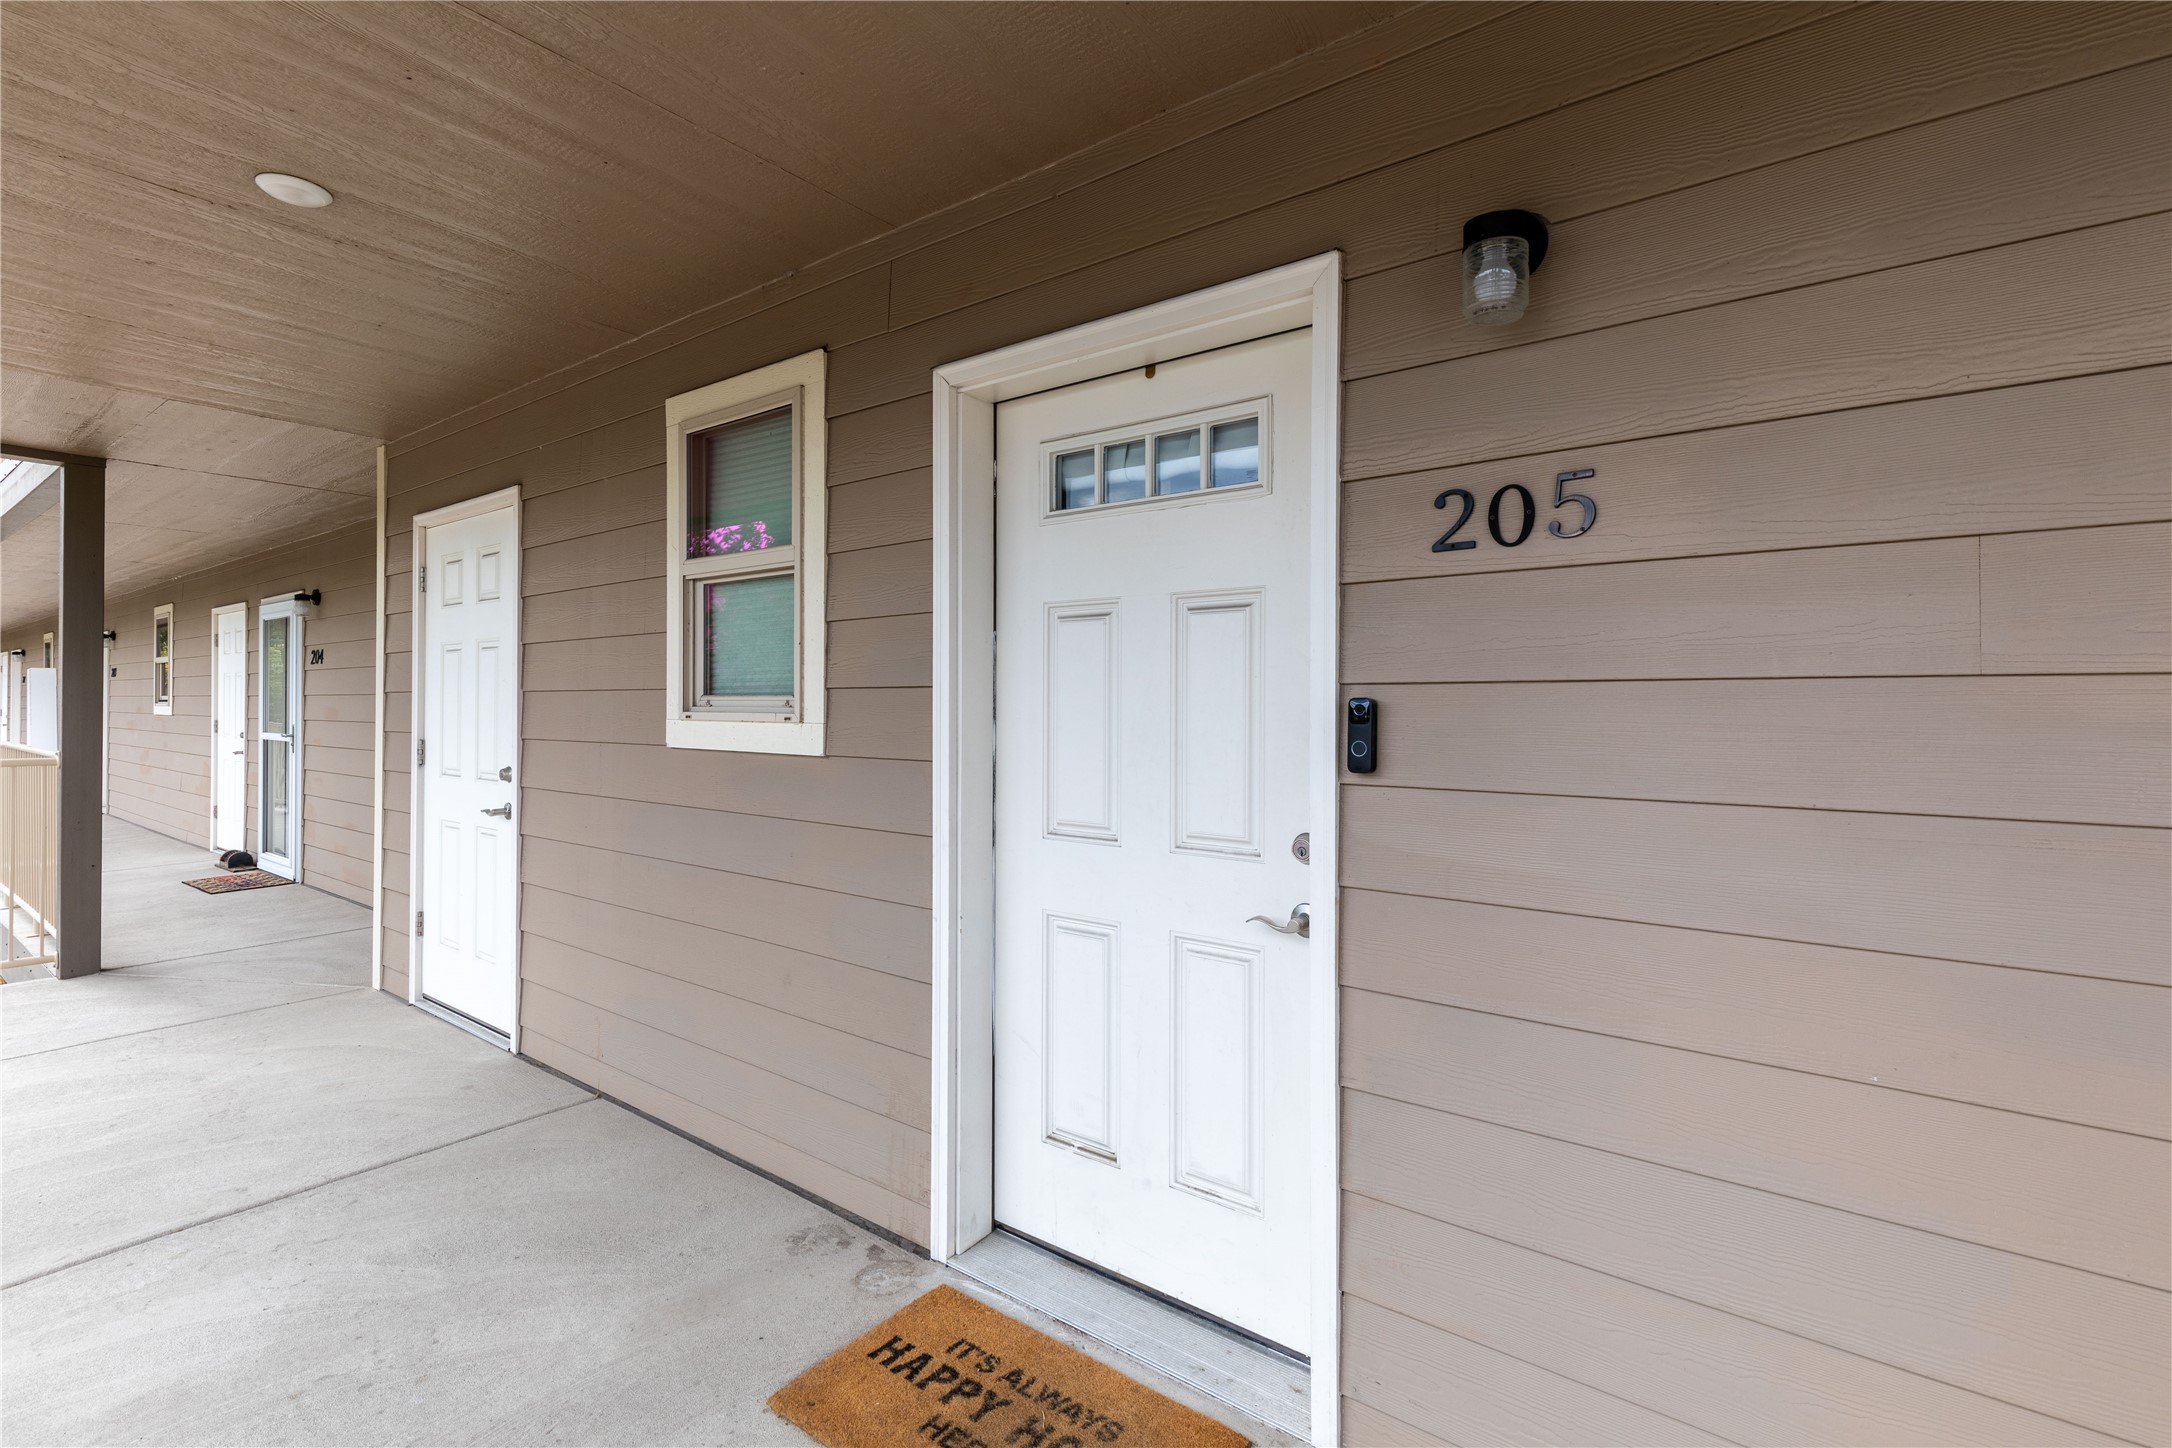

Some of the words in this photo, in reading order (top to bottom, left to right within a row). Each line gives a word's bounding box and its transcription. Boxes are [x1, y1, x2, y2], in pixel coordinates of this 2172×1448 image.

[1432, 468, 1597, 553] 205
[310, 648, 325, 665] 204
[866, 1335, 1014, 1423] HAPPY
[945, 1337, 1001, 1374] IT'S
[996, 1368, 1125, 1443] ALWAYS
